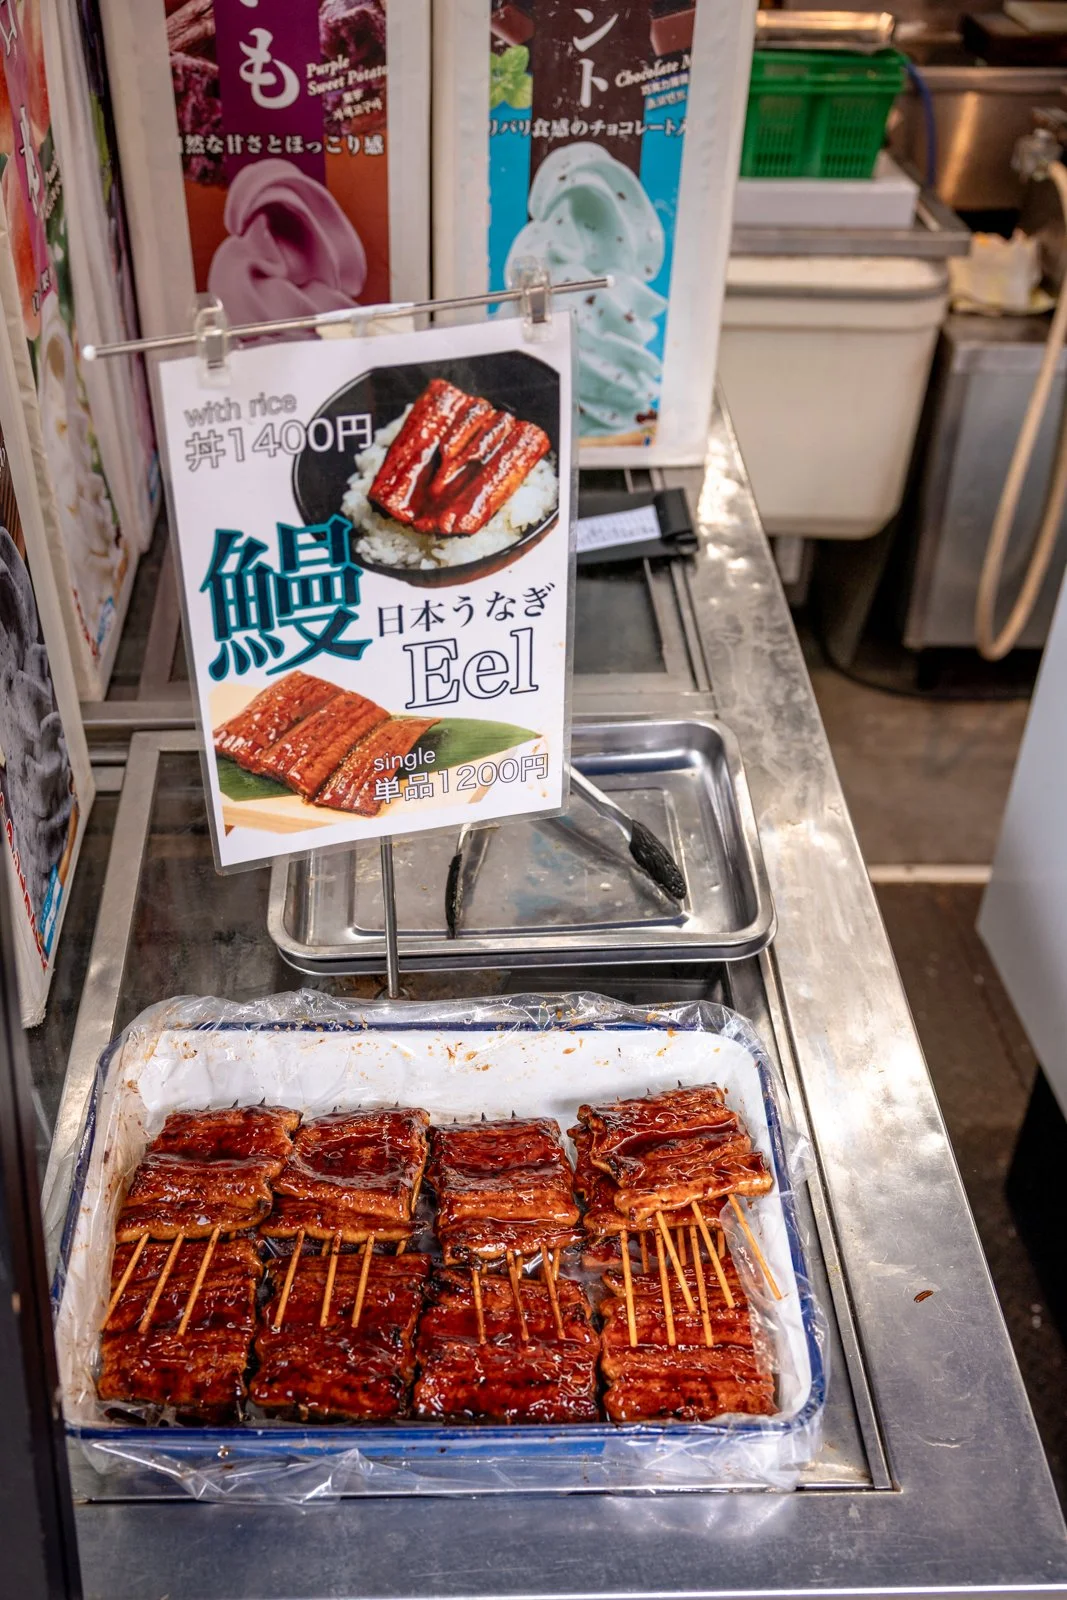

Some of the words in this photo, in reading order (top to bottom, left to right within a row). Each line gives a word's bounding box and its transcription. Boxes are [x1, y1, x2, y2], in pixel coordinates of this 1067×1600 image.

[306, 54, 350, 79] Purple
[307, 75, 346, 97] Sweet
[615, 58, 679, 88] Chocolate
[183, 397, 242, 428] with
[249, 391, 298, 418] rice
[184, 413, 374, 472] 丼1400円
[199, 513, 374, 682] 鰻
[378, 581, 556, 638] 日本うなぎ
[403, 626, 540, 710] Eel
[373, 747, 436, 772] single
[373, 752, 550, 805] 単品1200円
